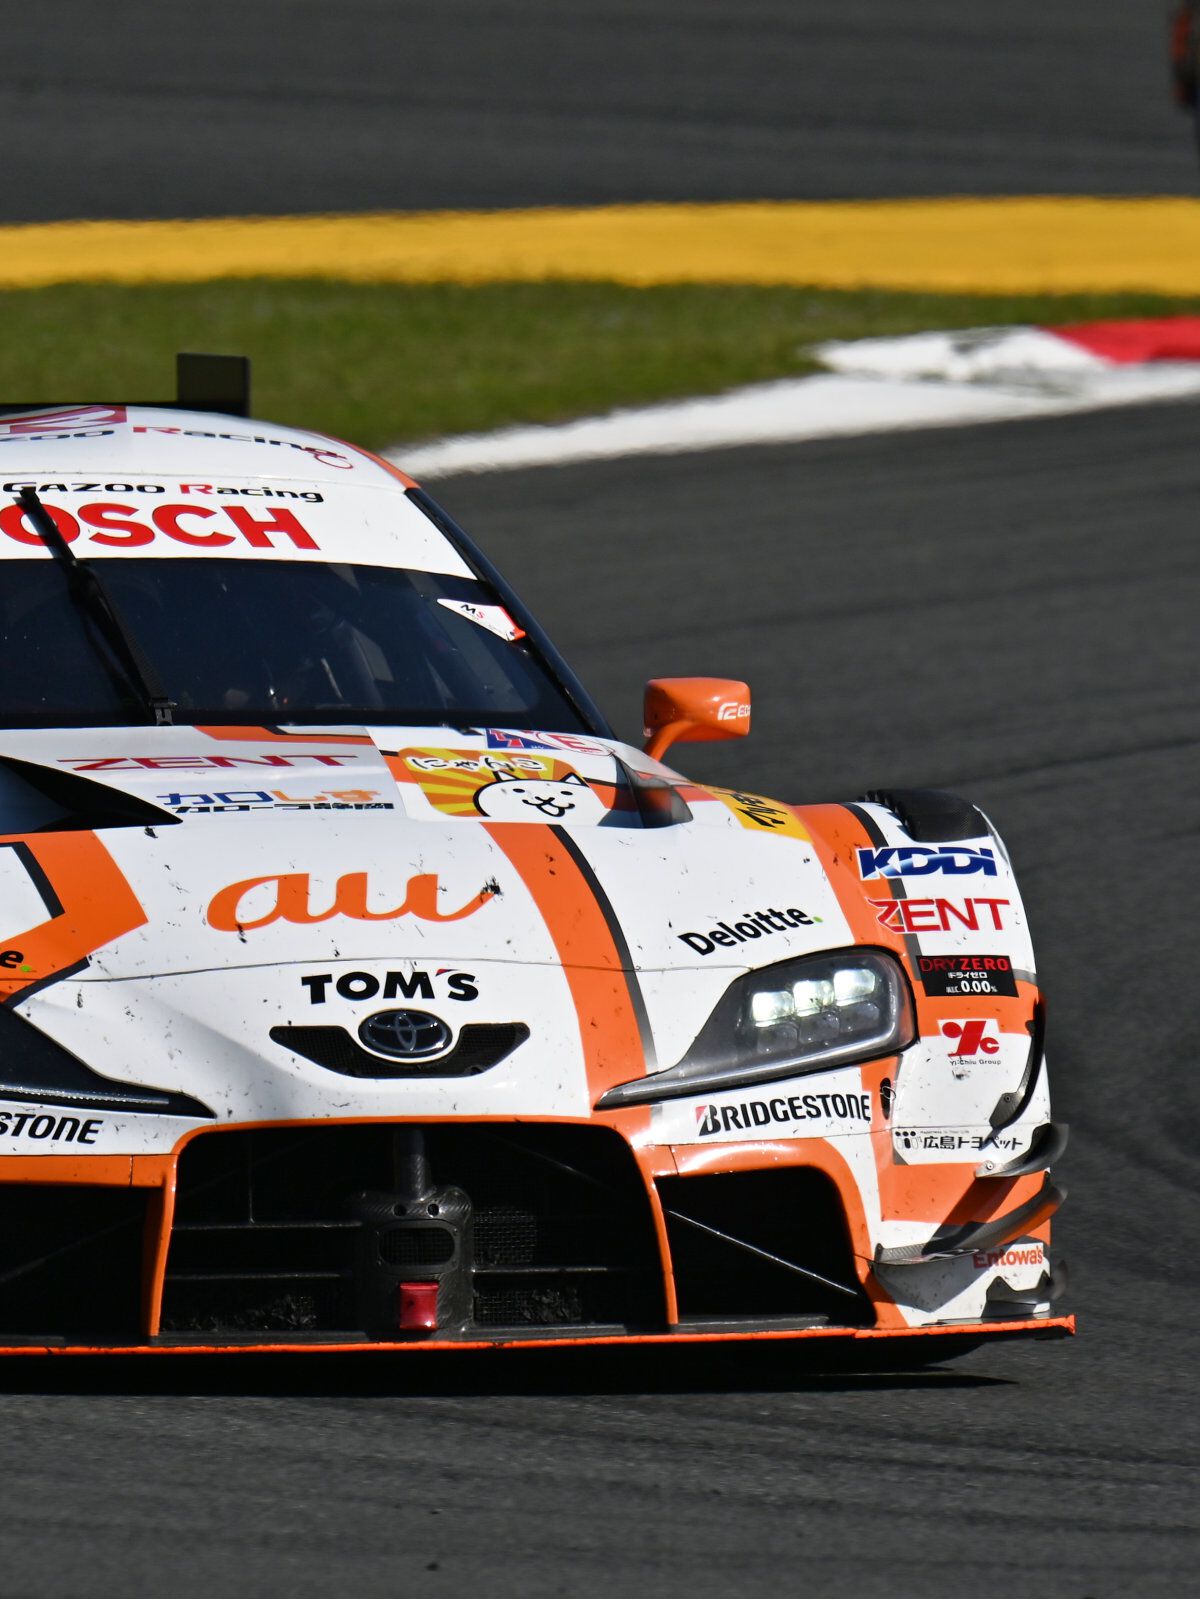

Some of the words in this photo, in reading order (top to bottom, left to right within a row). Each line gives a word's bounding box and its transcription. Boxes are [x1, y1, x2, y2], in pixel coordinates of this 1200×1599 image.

[3, 481, 165, 495] GAZOO
[180, 483, 324, 503] Racing
[57, 753, 358, 773] ZENT
[857, 846, 998, 879] KDDI
[207, 871, 501, 933] au
[867, 897, 1011, 933] ZENT
[301, 968, 479, 1005] TOM'S
[947, 971, 988, 979] ドライゼロ
[695, 1093, 871, 1137] BRIDGESTONE
[923, 1135, 1024, 1151] 広島トヨペット
[973, 1245, 1045, 1269] Entowa's
